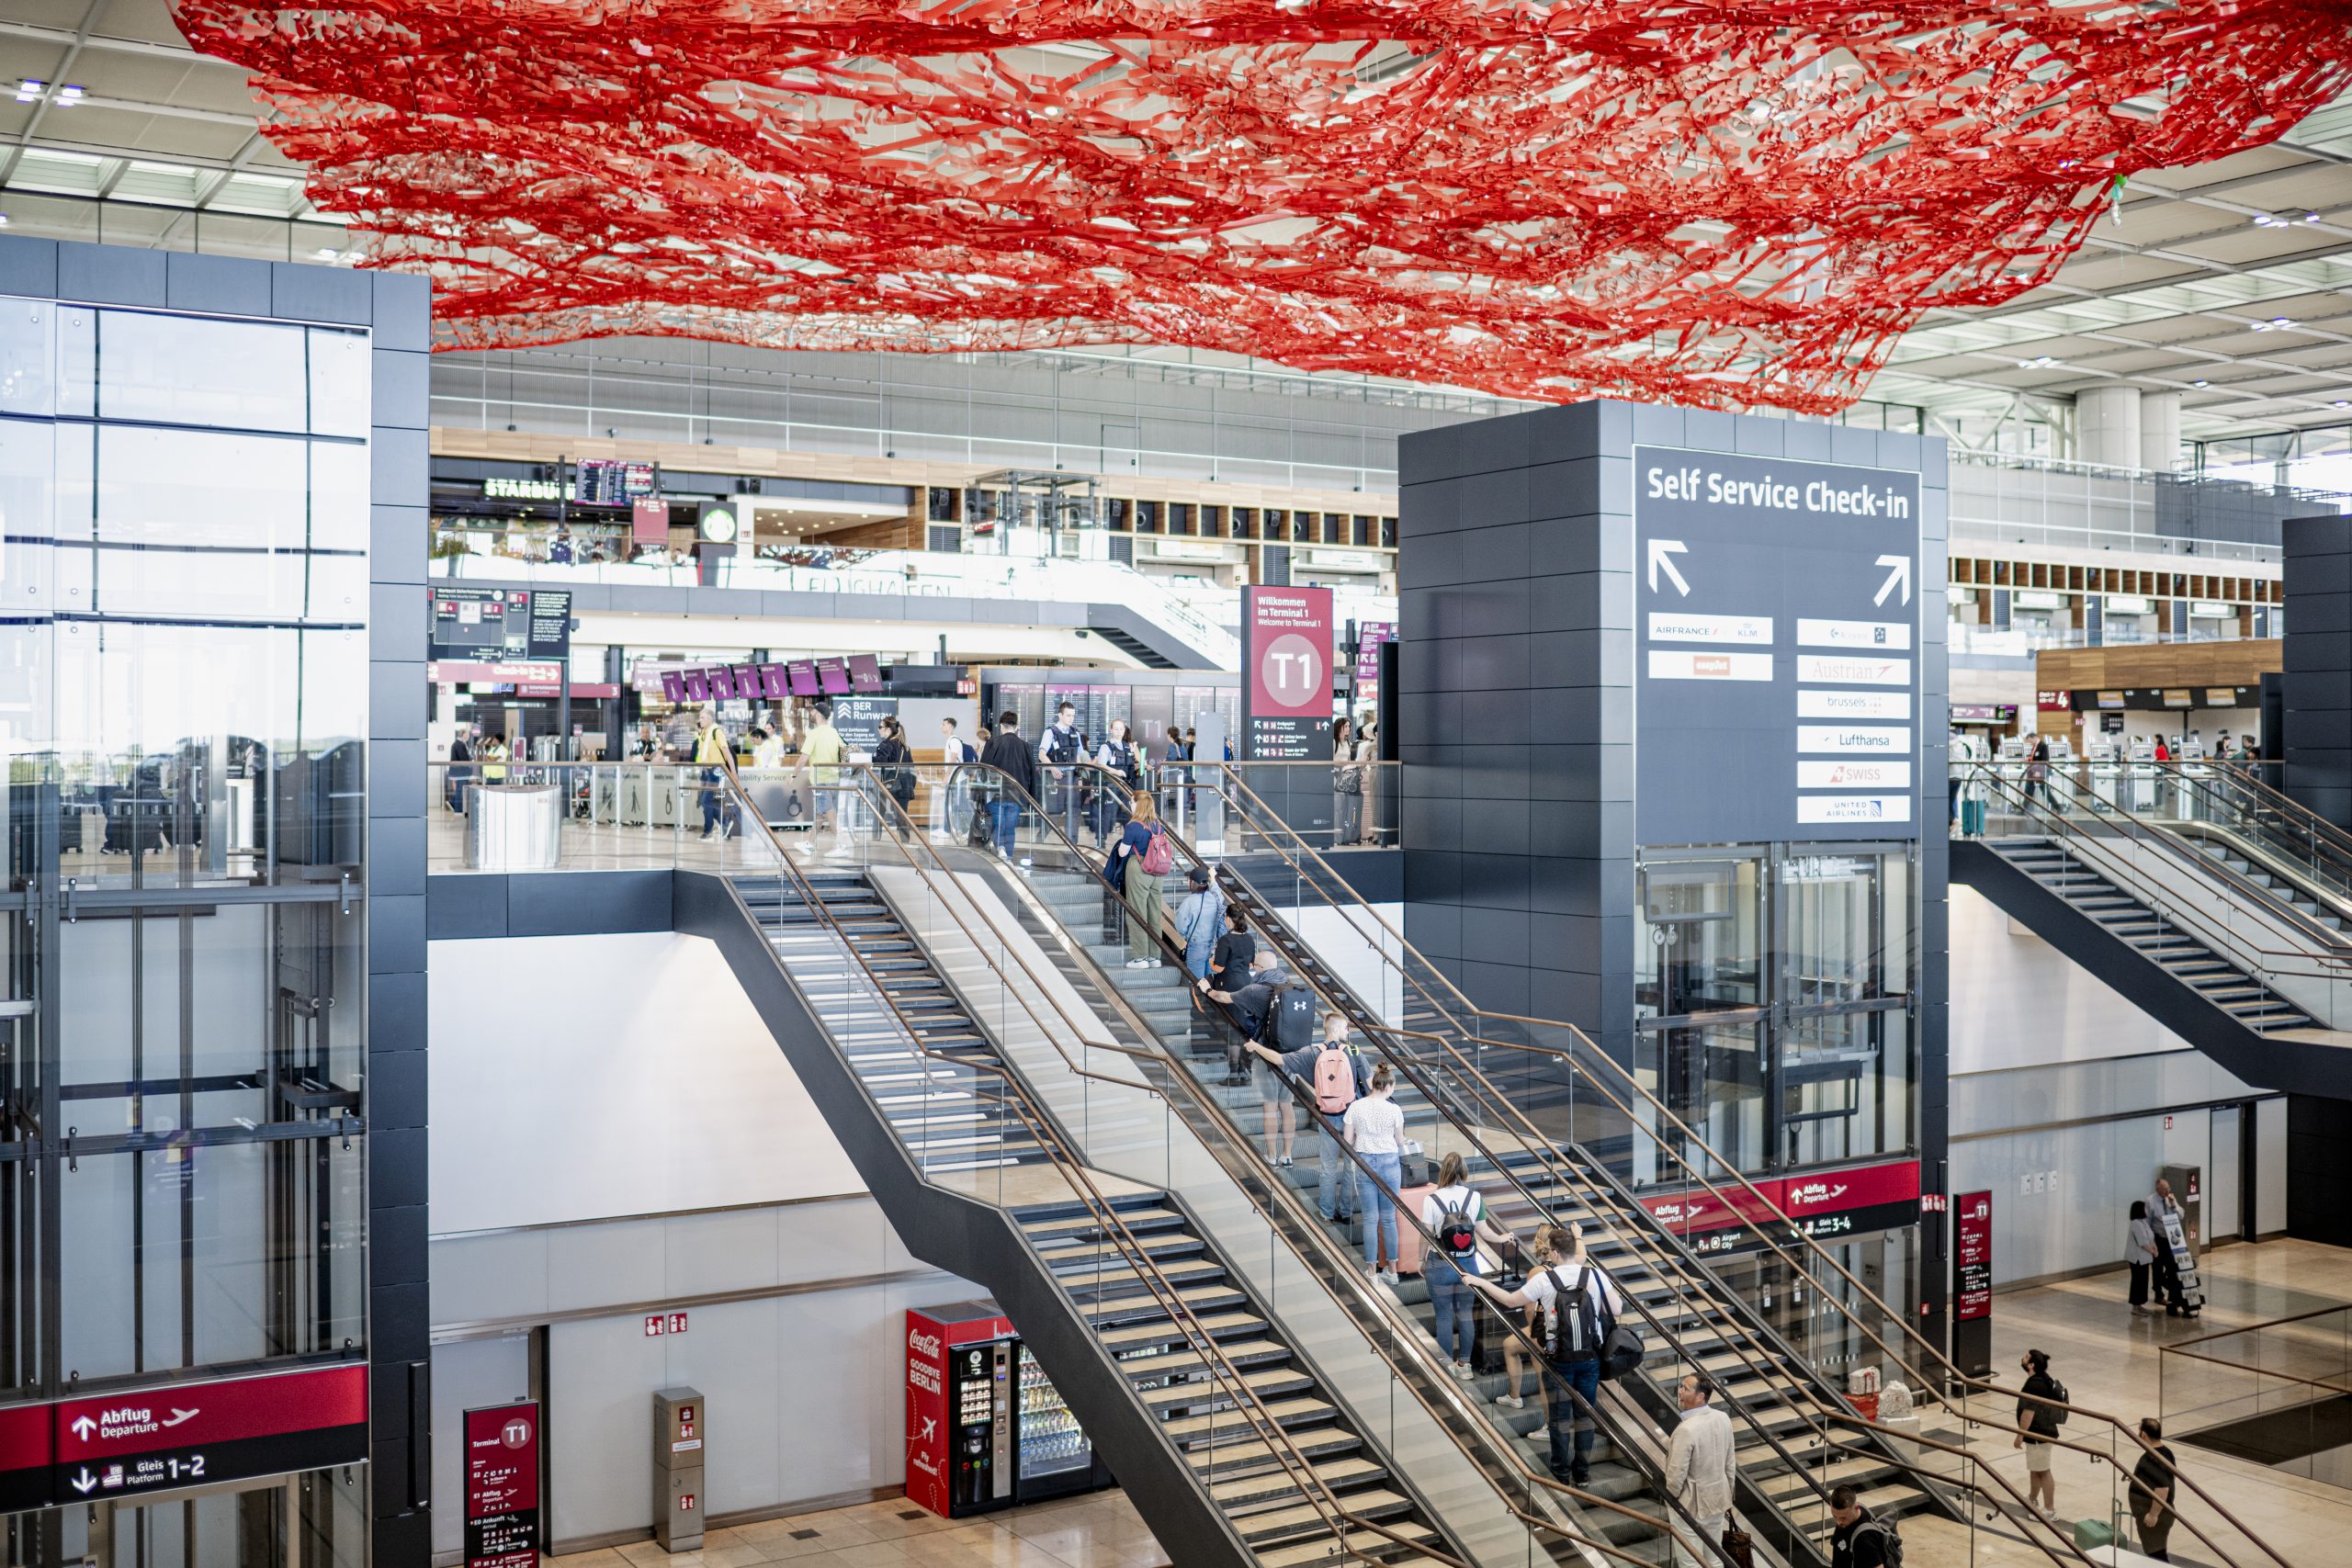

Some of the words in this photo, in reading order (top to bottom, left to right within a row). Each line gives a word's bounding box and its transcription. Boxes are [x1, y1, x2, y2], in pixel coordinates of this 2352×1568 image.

[1647, 468, 1701, 502] Self
[1707, 473, 1799, 511] Service
[1805, 480, 1909, 520] Check-in
[1258, 596, 1306, 607] Willkommen
[1258, 608, 1269, 617] im
[1270, 608, 1304, 618] Terminal
[1305, 609, 1309, 618] 1
[1258, 618, 1285, 626] Welcome
[1293, 619, 1317, 627] Terminal
[1656, 626, 1710, 636] AIRFRANCE
[1737, 629, 1758, 637] KLM
[1271, 652, 1311, 689] T1
[1813, 661, 1873, 680] Austrian
[1827, 695, 1867, 707] brussels
[2058, 691, 2068, 707] 4
[854, 701, 871, 711] BER
[1140, 719, 1161, 739] T1
[1839, 733, 1890, 746] Lufthansa
[1846, 768, 1881, 781] SWISS
[1804, 1183, 1826, 1194] Abflug
[1804, 1193, 1829, 1203] Departure
[1656, 1205, 1679, 1216] Abflug
[1976, 1204, 1987, 1217] T1
[1819, 1218, 1831, 1226] Gleis
[1832, 1216, 1851, 1232] 3-4
[1722, 1233, 1741, 1242] Airport
[910, 1359, 941, 1380] GOODBYE
[910, 1369, 941, 1395] BERLIN
[100, 1407, 152, 1425] Abflug
[100, 1421, 158, 1438] Departure
[505, 1425, 526, 1442] T1
[472, 1438, 500, 1448] Terminal
[921, 1450, 929, 1462] Fly
[137, 1460, 164, 1473] Gleis
[168, 1455, 205, 1480] 1-2
[127, 1472, 164, 1484] Platform
[482, 1490, 501, 1498] Abflug
[482, 1516, 505, 1524] Ankunft
